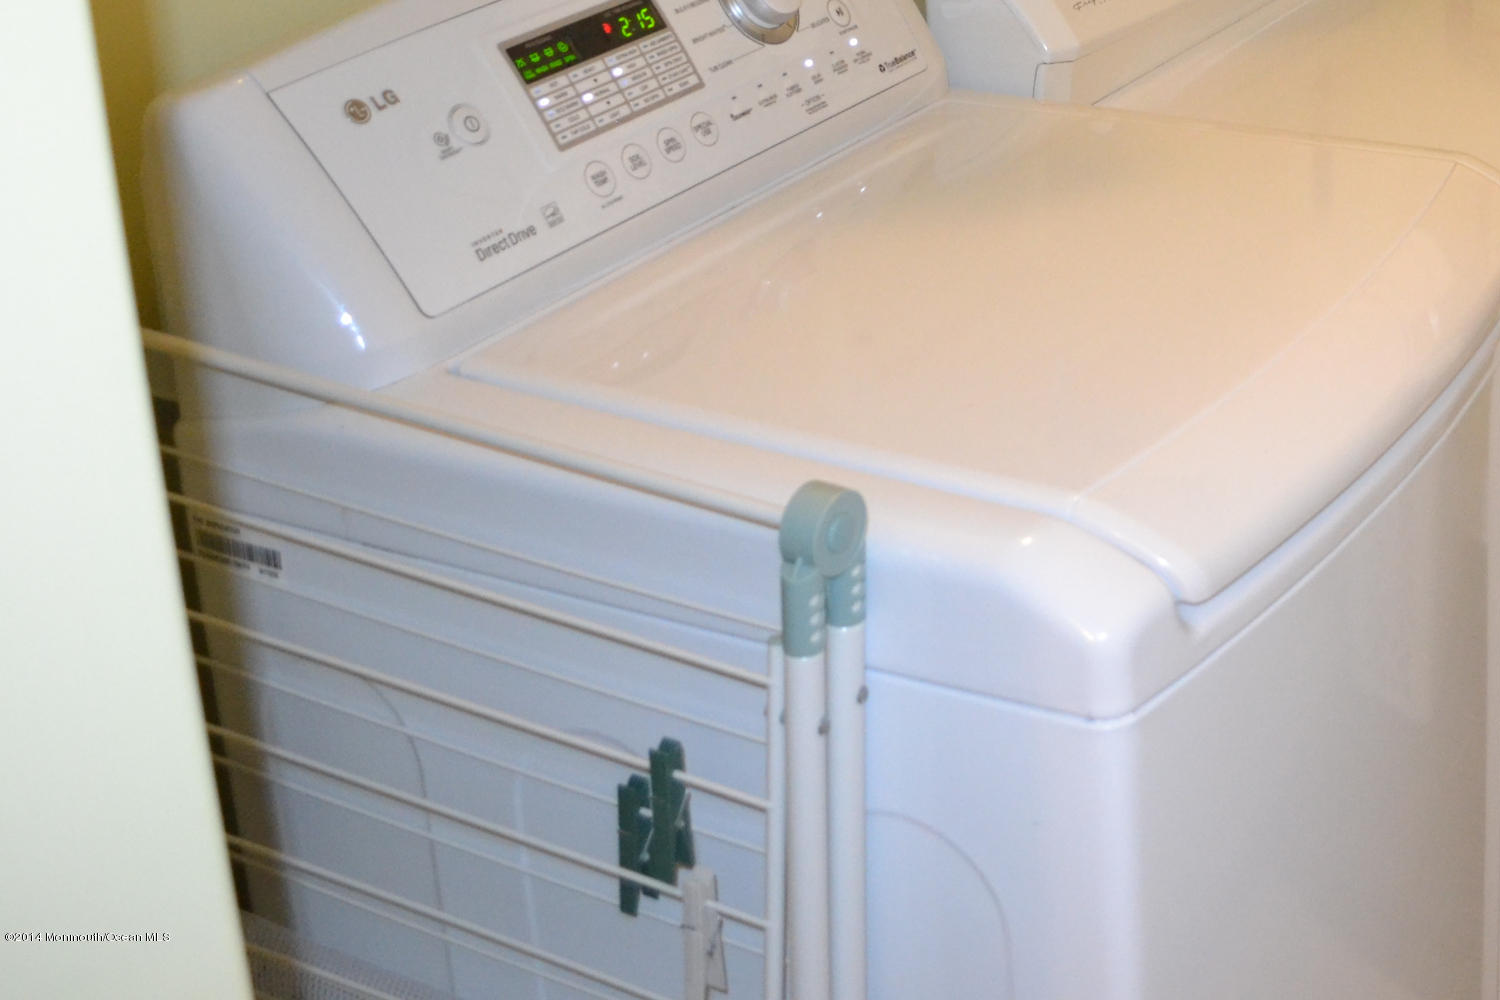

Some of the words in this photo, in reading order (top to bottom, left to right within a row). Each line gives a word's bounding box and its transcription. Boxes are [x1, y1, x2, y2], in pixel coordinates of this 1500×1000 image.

[369, 89, 400, 111] LG
[474, 237, 509, 262] Direct
[507, 224, 537, 246] Drive
